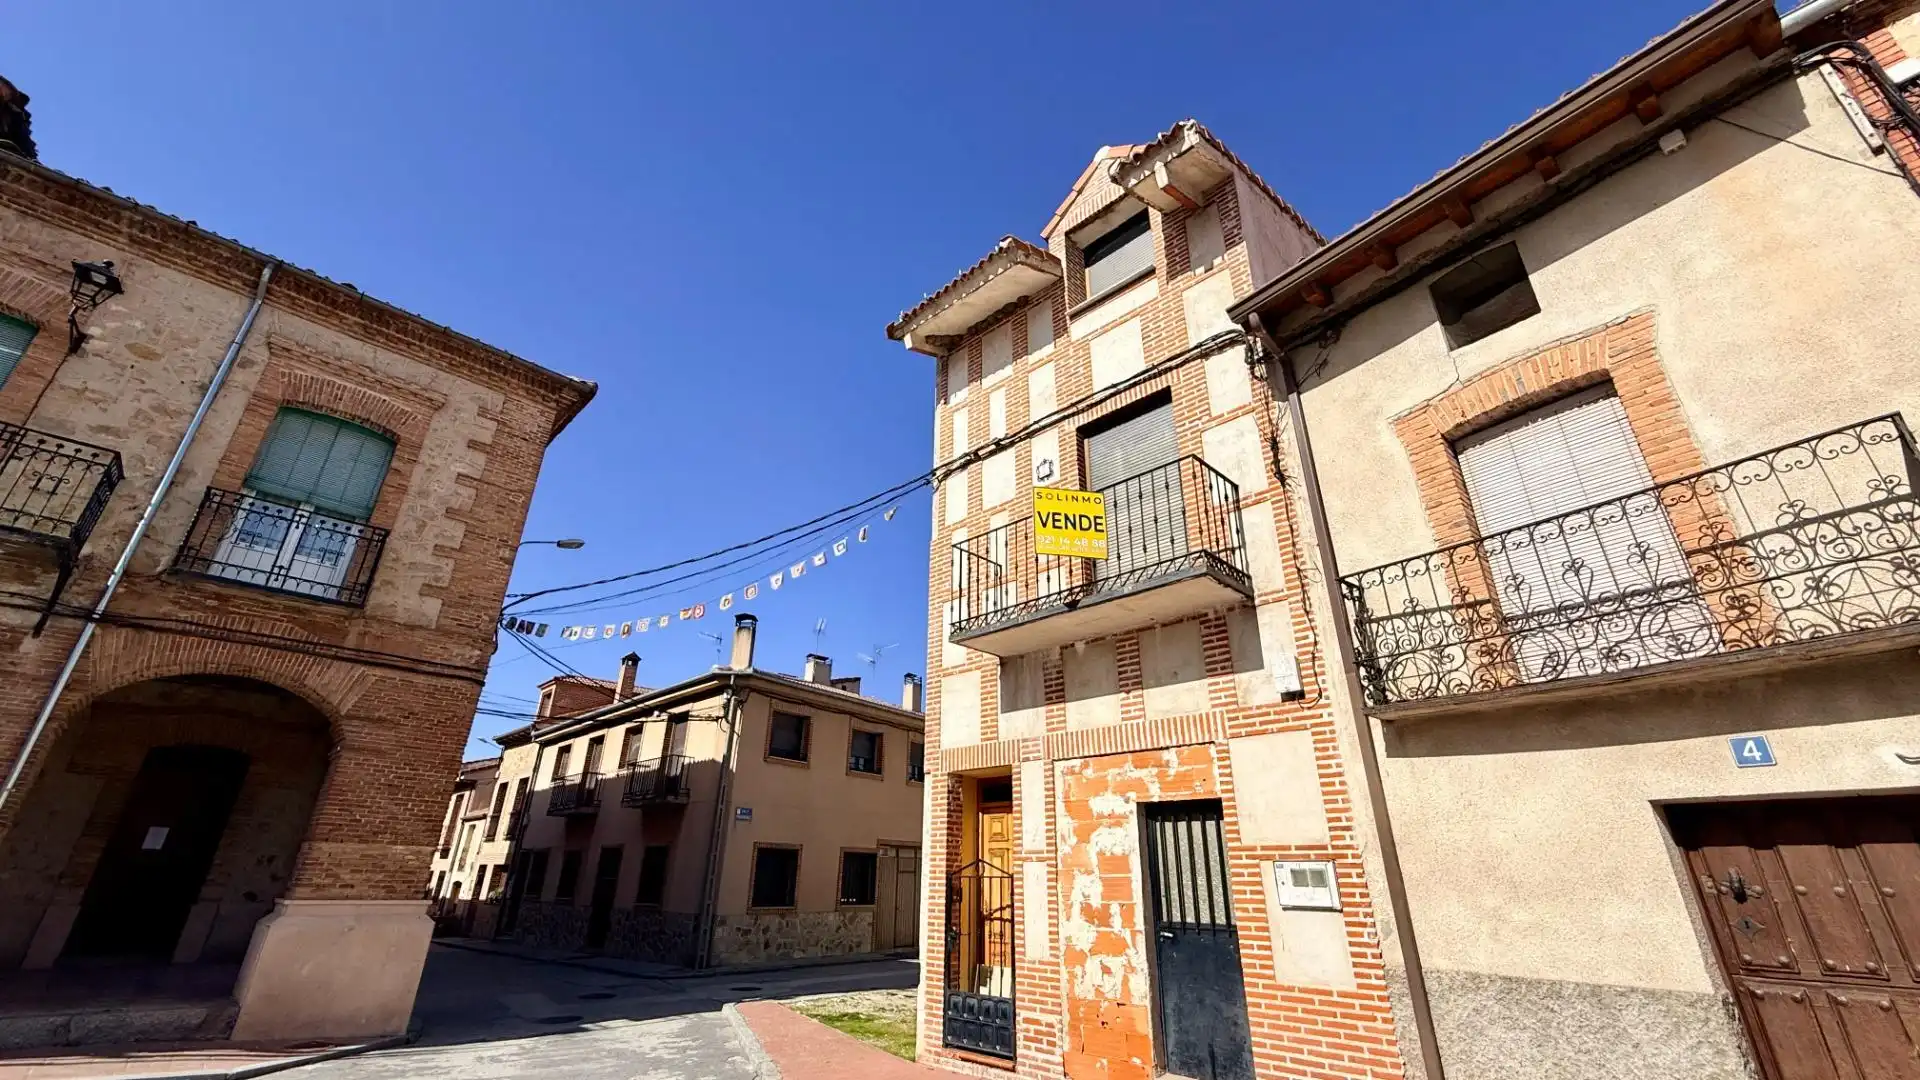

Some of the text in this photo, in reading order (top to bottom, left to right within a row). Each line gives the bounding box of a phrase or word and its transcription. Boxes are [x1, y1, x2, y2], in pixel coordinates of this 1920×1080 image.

[1036, 492, 1102, 504] SOLINMO
[1036, 511, 1105, 533] VENDE
[1743, 740, 1762, 761] 4
